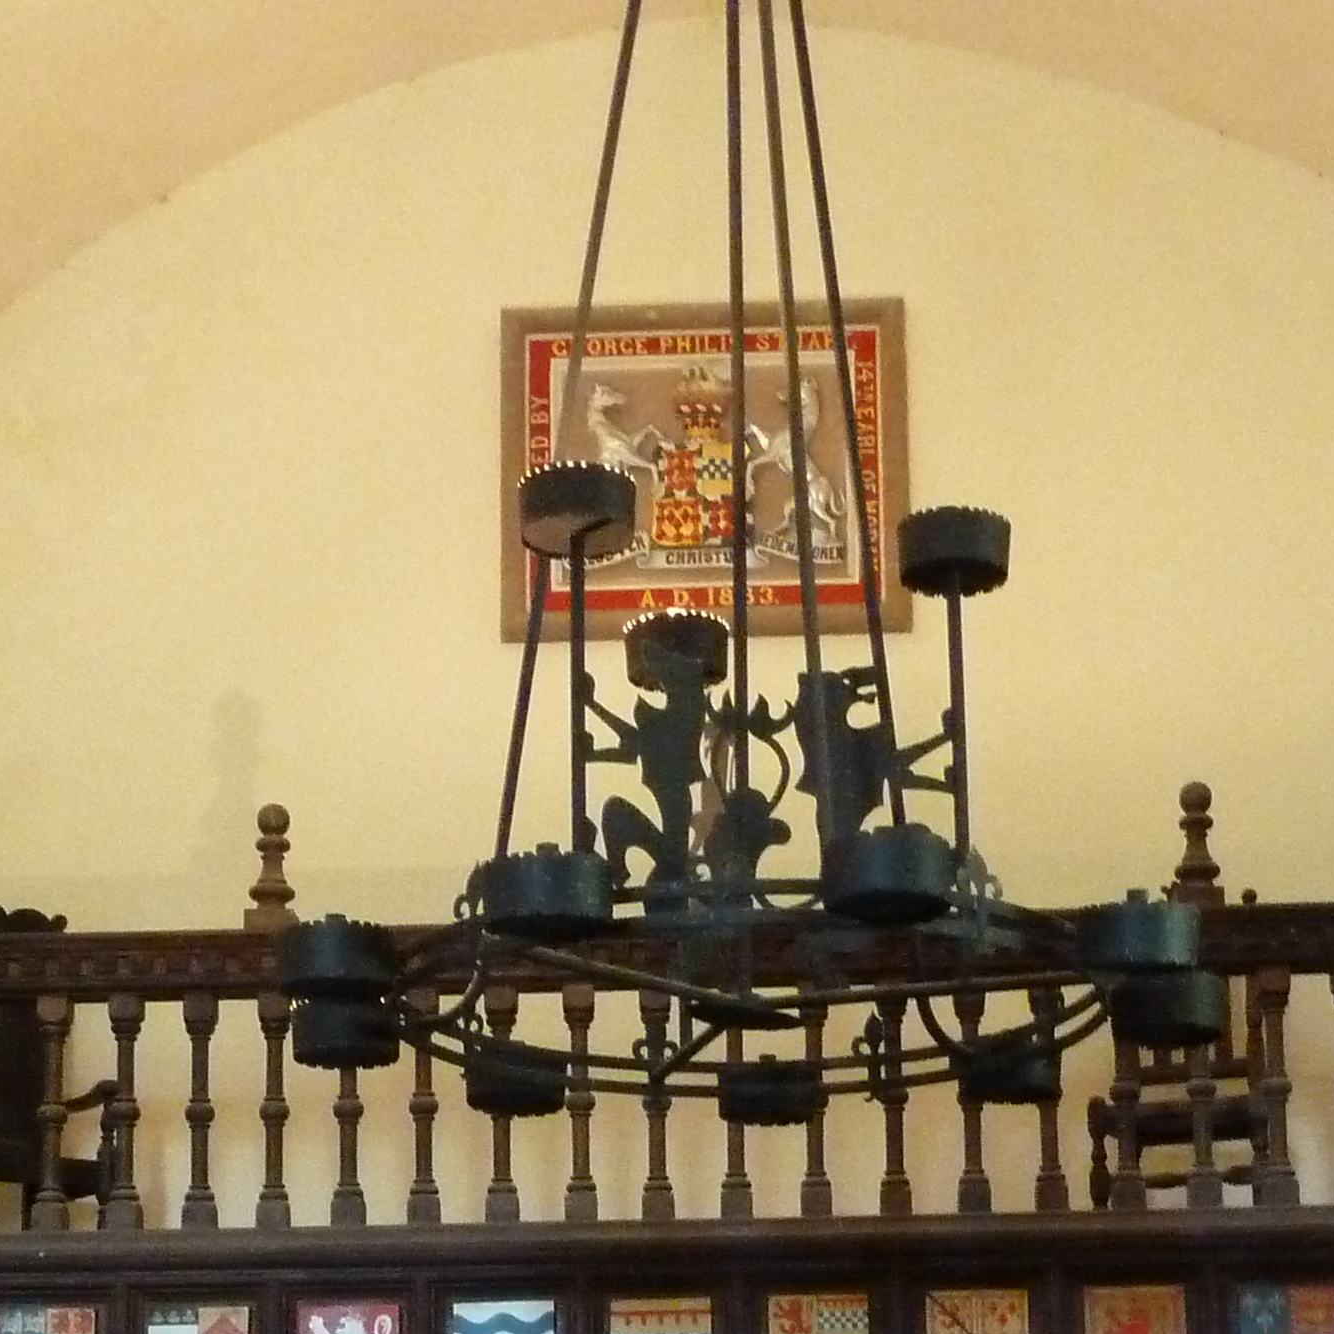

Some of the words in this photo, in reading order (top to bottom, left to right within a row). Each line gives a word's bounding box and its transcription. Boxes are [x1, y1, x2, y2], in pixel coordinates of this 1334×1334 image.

[551, 336, 648, 356] GORGE
[660, 333, 733, 354] PHILI
[531, 396, 548, 424] BY
[665, 550, 733, 565] CHRISTU
